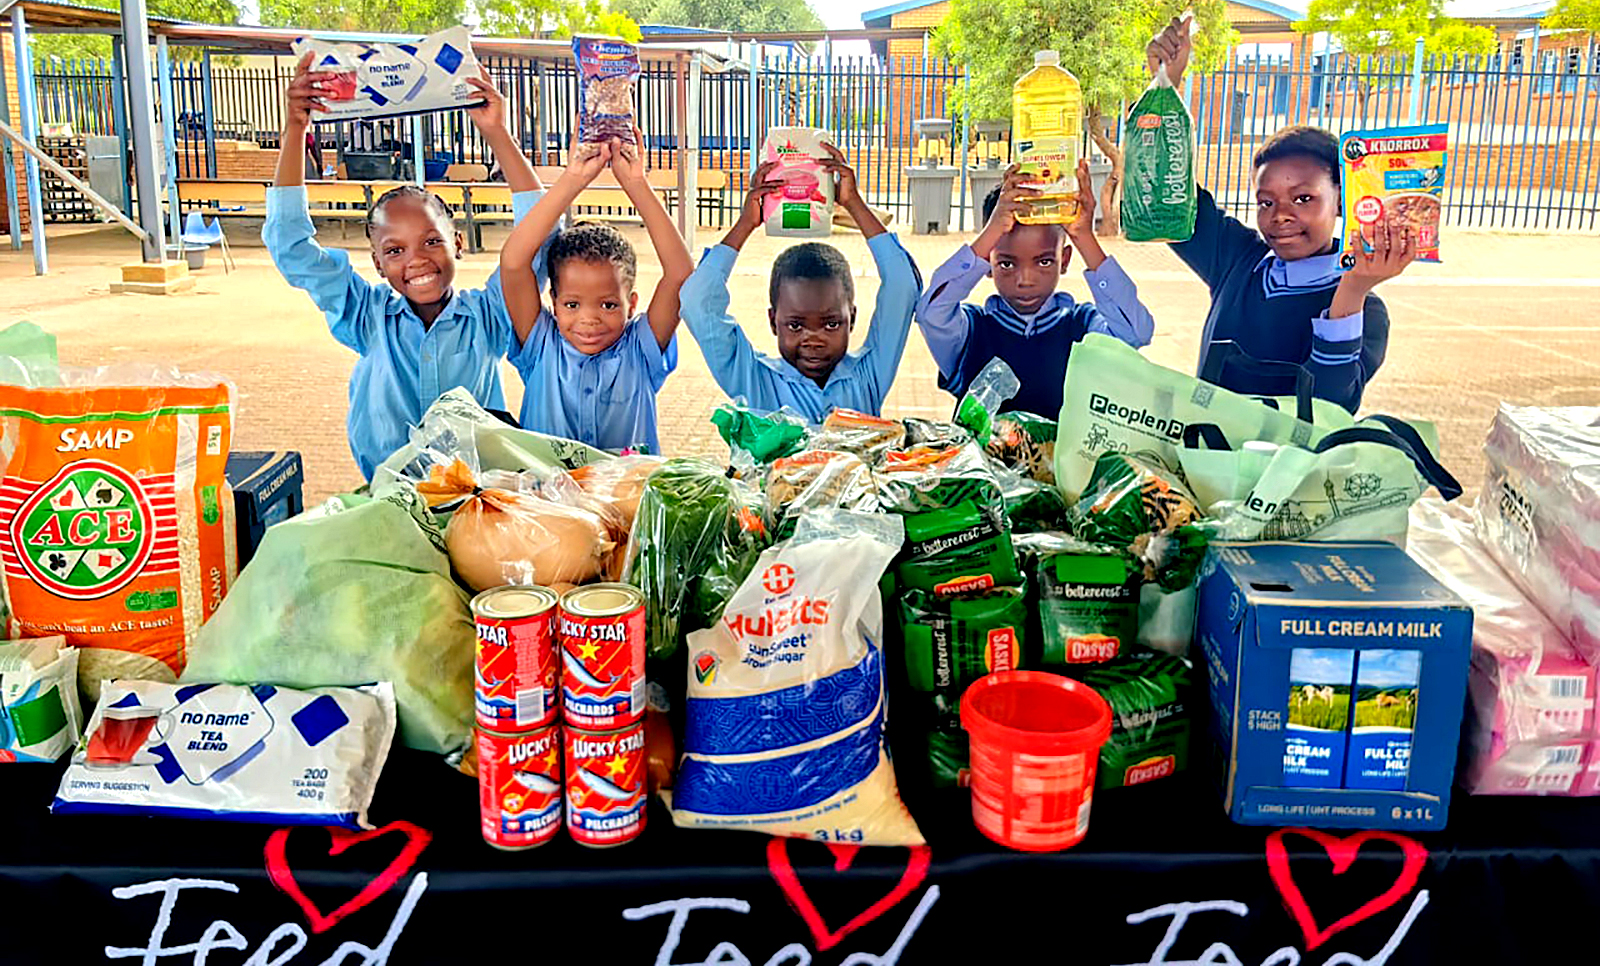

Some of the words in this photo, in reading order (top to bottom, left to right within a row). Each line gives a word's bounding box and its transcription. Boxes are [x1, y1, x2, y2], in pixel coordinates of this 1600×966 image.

[369, 65, 382, 73] no
[383, 62, 410, 72] name
[1370, 138, 1430, 152] KNORROX
[55, 427, 135, 453] SAMP
[28, 508, 137, 546] ACE
[63, 622, 86, 633] beat
[90, 624, 105, 633] an
[109, 621, 136, 632] ACE
[140, 615, 174, 629] taste!
[560, 618, 587, 638] UCKY
[590, 622, 626, 642] STAR
[1280, 619, 1325, 635] FULL
[1328, 620, 1393, 636] CREAM
[1397, 622, 1442, 638] MILK
[1072, 641, 1115, 659] SASKO
[180, 712, 203, 724] no
[204, 713, 249, 726] name
[1248, 710, 1281, 719] STACK
[1256, 721, 1281, 730] HIGH
[201, 730, 223, 741] TEA
[187, 741, 228, 751] BLEND
[508, 737, 551, 765] LUCKY
[573, 738, 616, 759] LUCKY
[1286, 745, 1330, 758] CREAM
[1364, 748, 1393, 759] FULL
[1385, 760, 1409, 770] MIL
[304, 768, 328, 779] 200
[297, 788, 316, 798] 400
[815, 829, 829, 842] 3
[834, 829, 863, 842] kg
